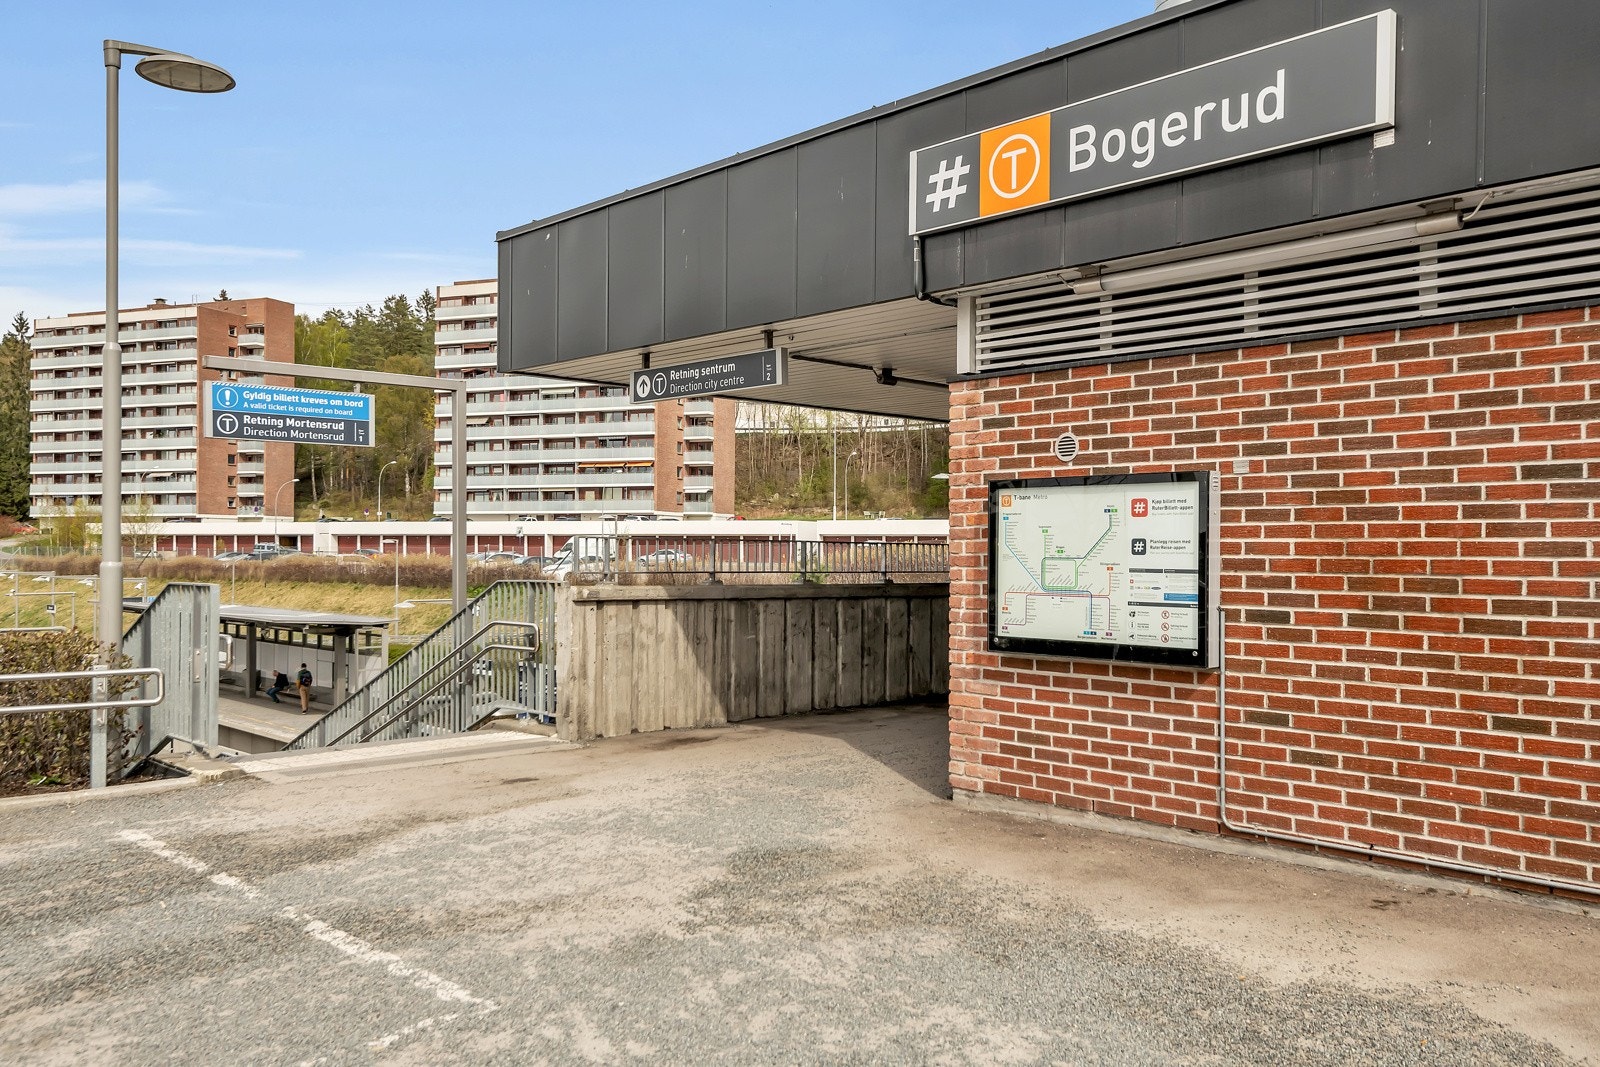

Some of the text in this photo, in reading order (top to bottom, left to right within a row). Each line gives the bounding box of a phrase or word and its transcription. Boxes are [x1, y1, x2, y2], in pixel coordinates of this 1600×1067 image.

[1069, 68, 1286, 172] Bogerud
[670, 363, 736, 380] Retning sentrum
[766, 373, 771, 381] 2
[670, 375, 745, 394] Direction city centre
[243, 391, 272, 403] Gyldig
[273, 393, 300, 404] billett
[301, 396, 329, 405] kreves
[344, 398, 363, 408] bord
[295, 406, 323, 414] required
[334, 408, 353, 416] board
[243, 415, 345, 430] Retning Mortensrud
[243, 427, 288, 438] Direction
[290, 429, 345, 441] Mortensrud
